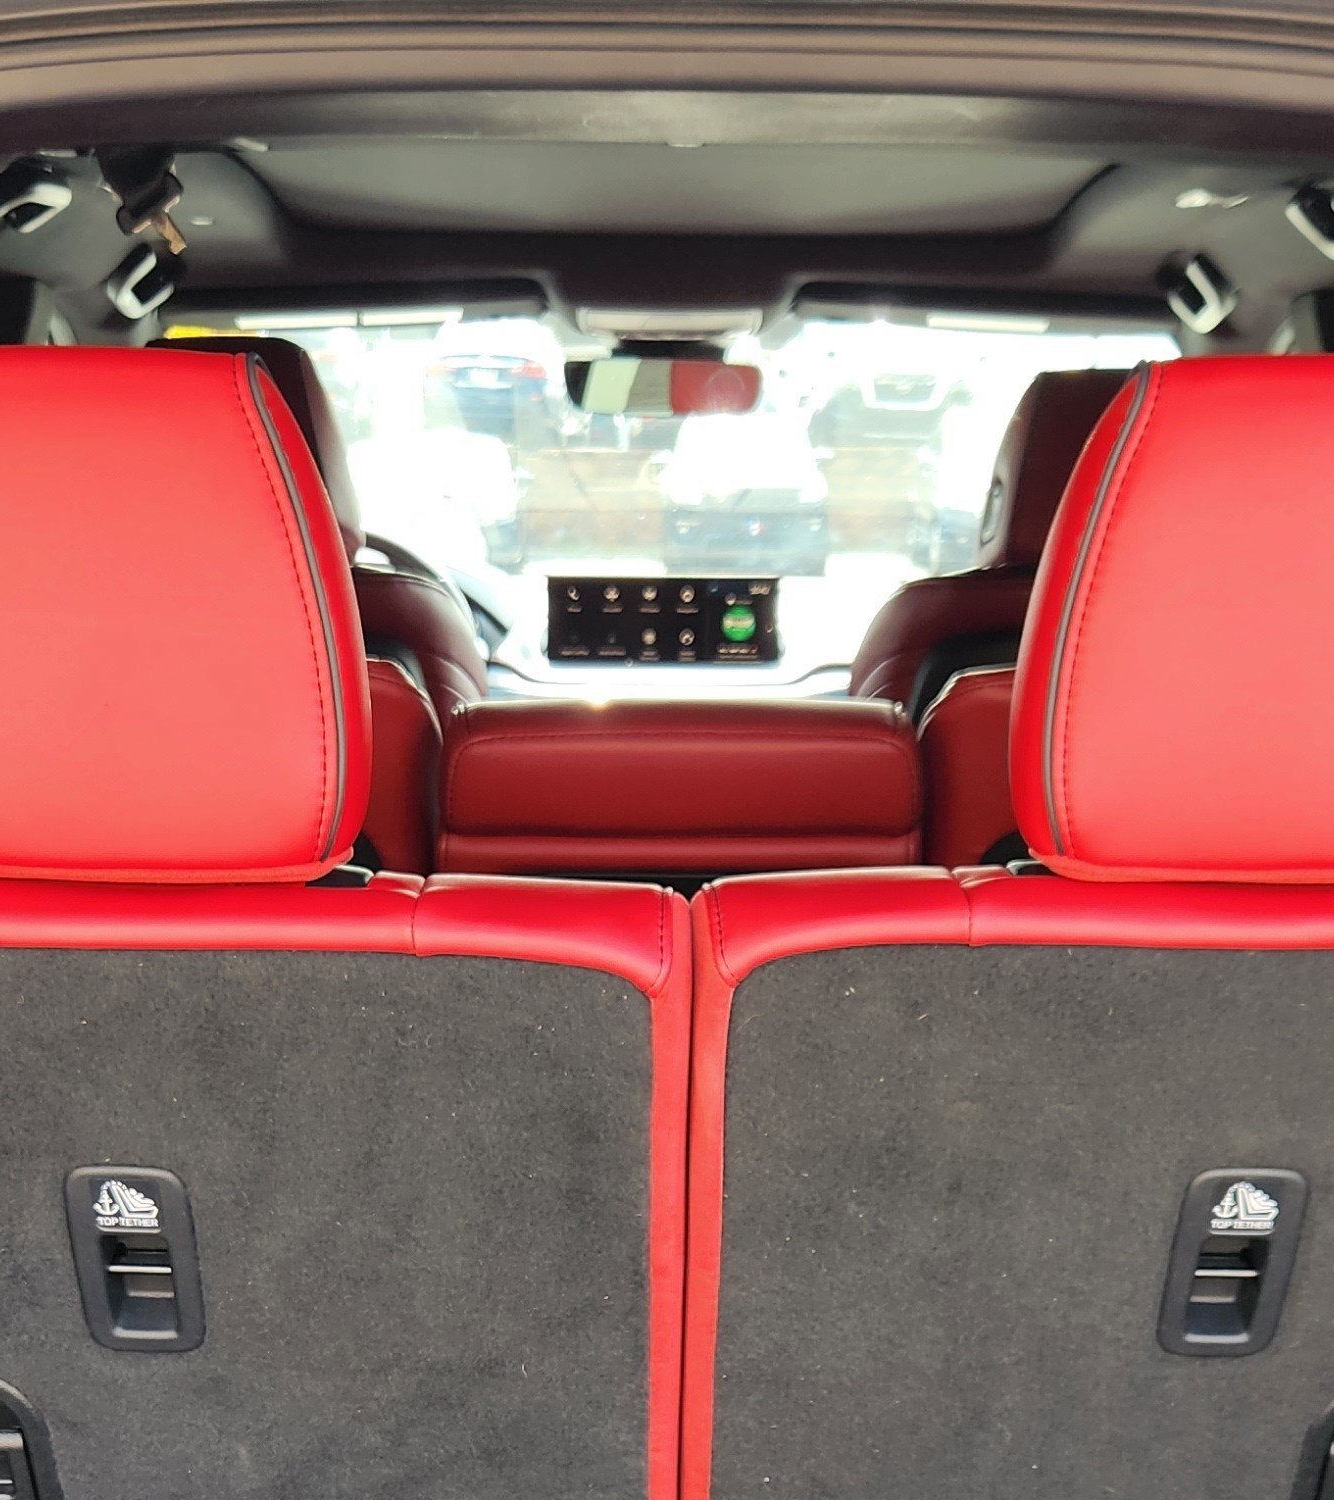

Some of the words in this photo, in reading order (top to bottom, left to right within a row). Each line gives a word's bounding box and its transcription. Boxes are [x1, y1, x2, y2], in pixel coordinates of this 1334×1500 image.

[96, 1216, 119, 1227] TOP
[119, 1217, 159, 1227] TETHER
[1211, 1219, 1233, 1230] TOP
[1233, 1219, 1274, 1230] TETHER
